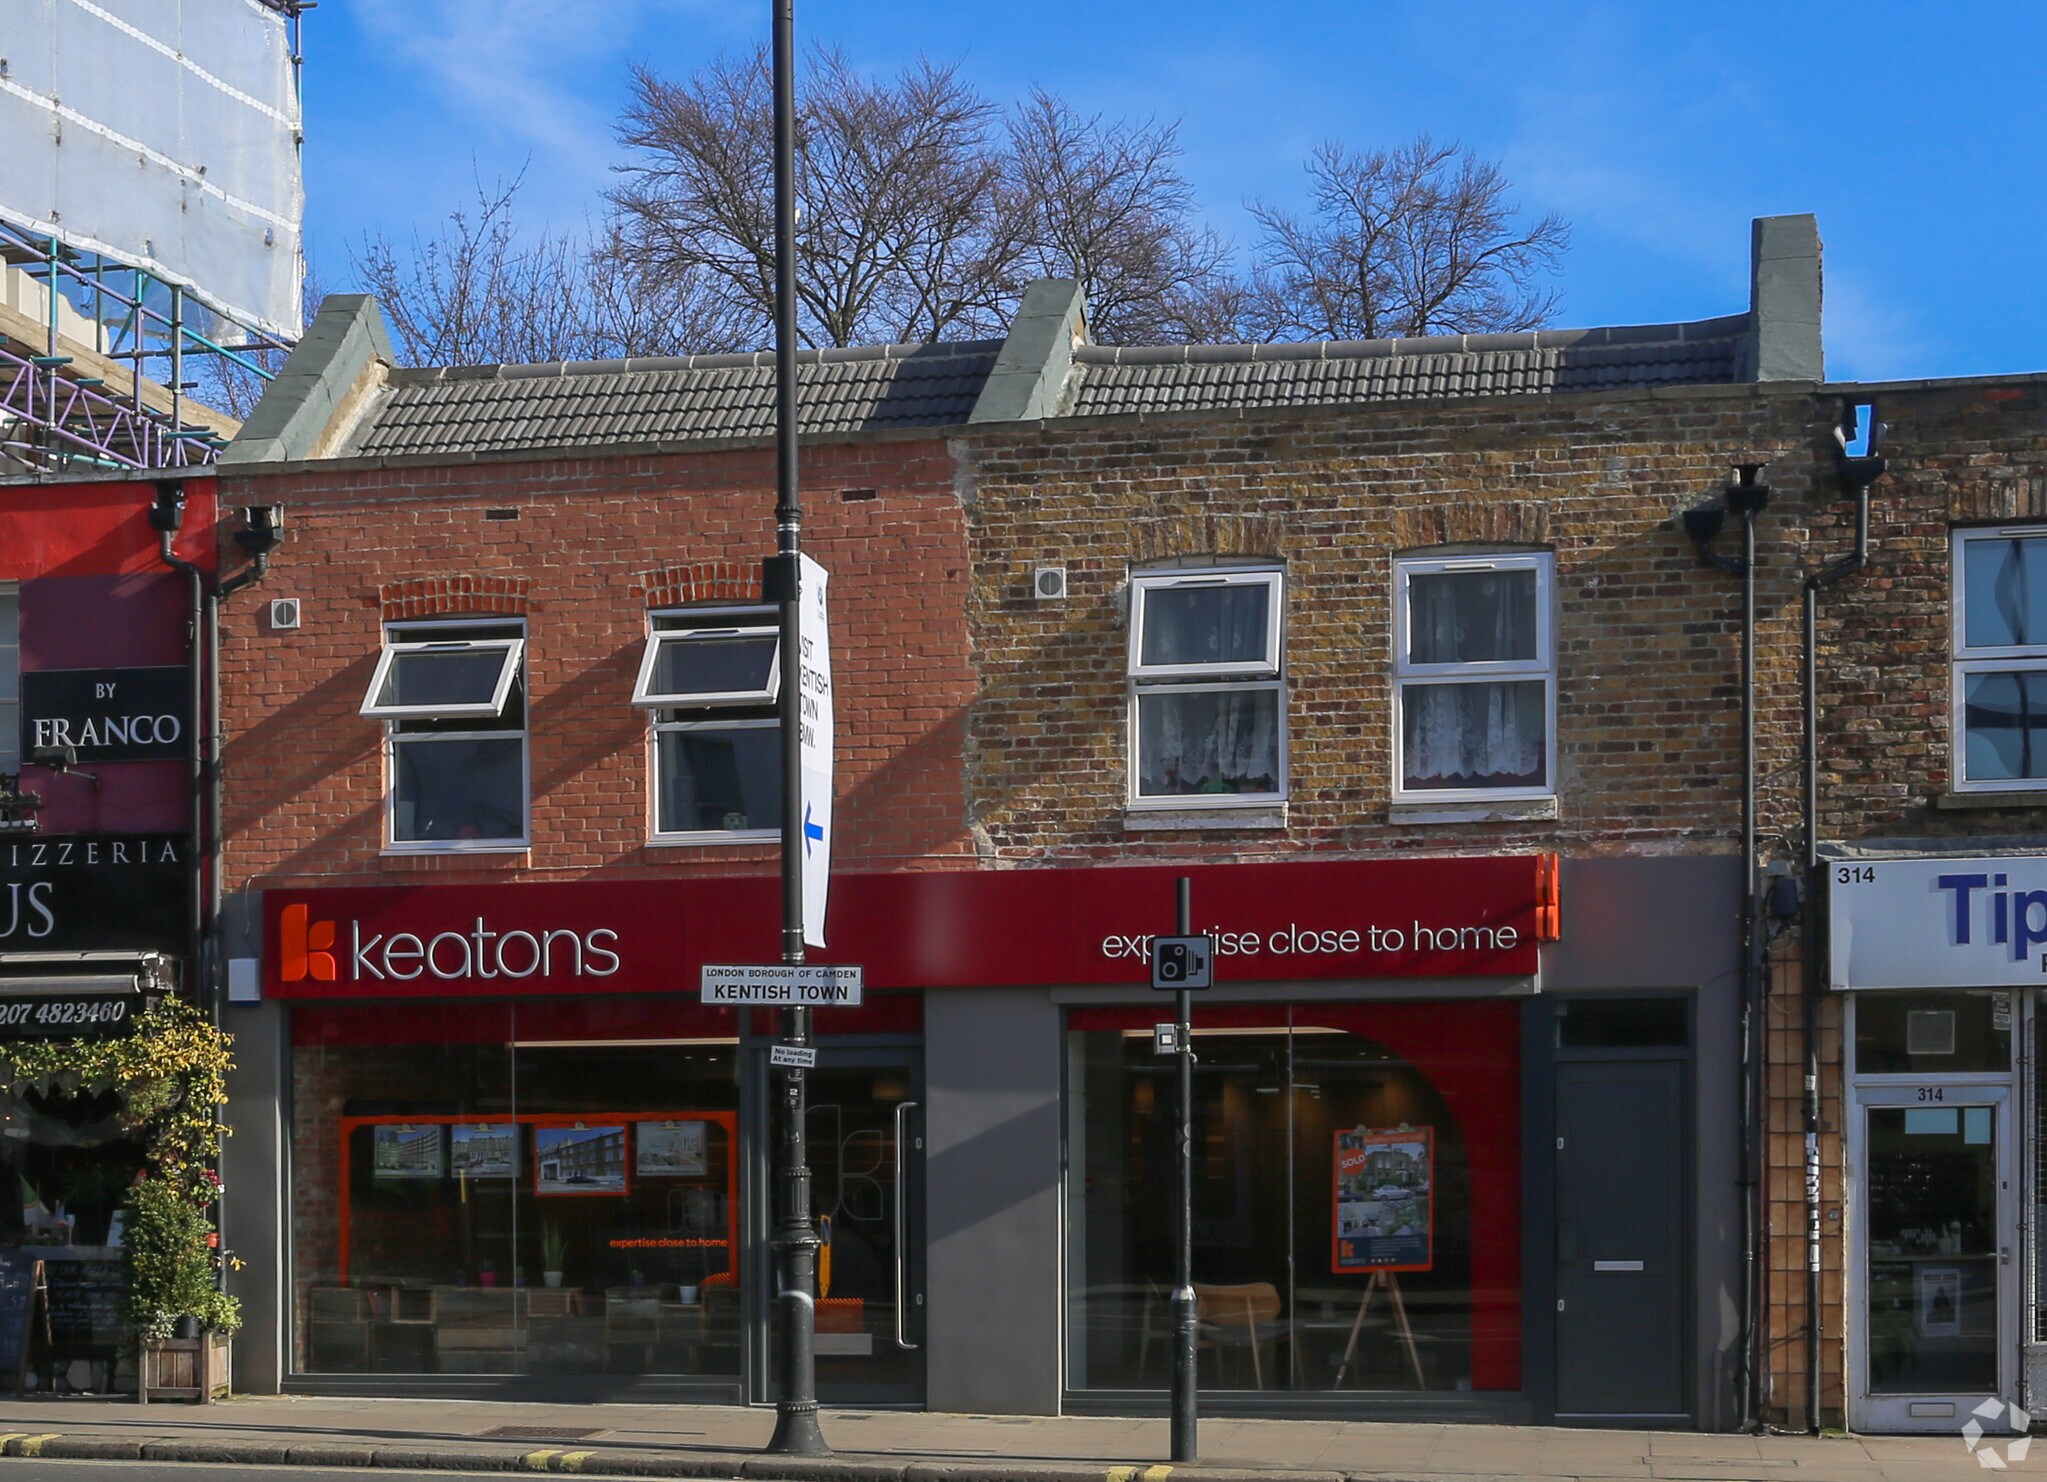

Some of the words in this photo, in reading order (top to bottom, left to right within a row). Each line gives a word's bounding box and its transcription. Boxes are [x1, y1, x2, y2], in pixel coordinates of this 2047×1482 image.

[96, 683, 116, 699] BY
[33, 715, 181, 748] FRANCO
[11, 840, 179, 866] IZZERIA
[1838, 866, 1876, 884] 314
[1937, 873, 2047, 960] Tip
[1268, 923, 1359, 954] close
[1367, 924, 1405, 951] to
[1414, 920, 1517, 951] home
[352, 916, 620, 980] keatons
[706, 969, 744, 978] LONDON
[749, 969, 794, 978] BOROUGH
[799, 970, 811, 978] OF
[816, 970, 856, 979] CAMDEN
[715, 984, 791, 999] KENTISH
[798, 985, 848, 1000] TOWN
[35, 1001, 125, 1023] 4823460
[787, 1049, 812, 1058] loading
[1917, 1088, 1943, 1101] 314
[1341, 1154, 1366, 1169] SOLD
[610, 1238, 657, 1248] expertise
[658, 1238, 685, 1247] close
[686, 1239, 697, 1247] to
[698, 1237, 728, 1247] home
